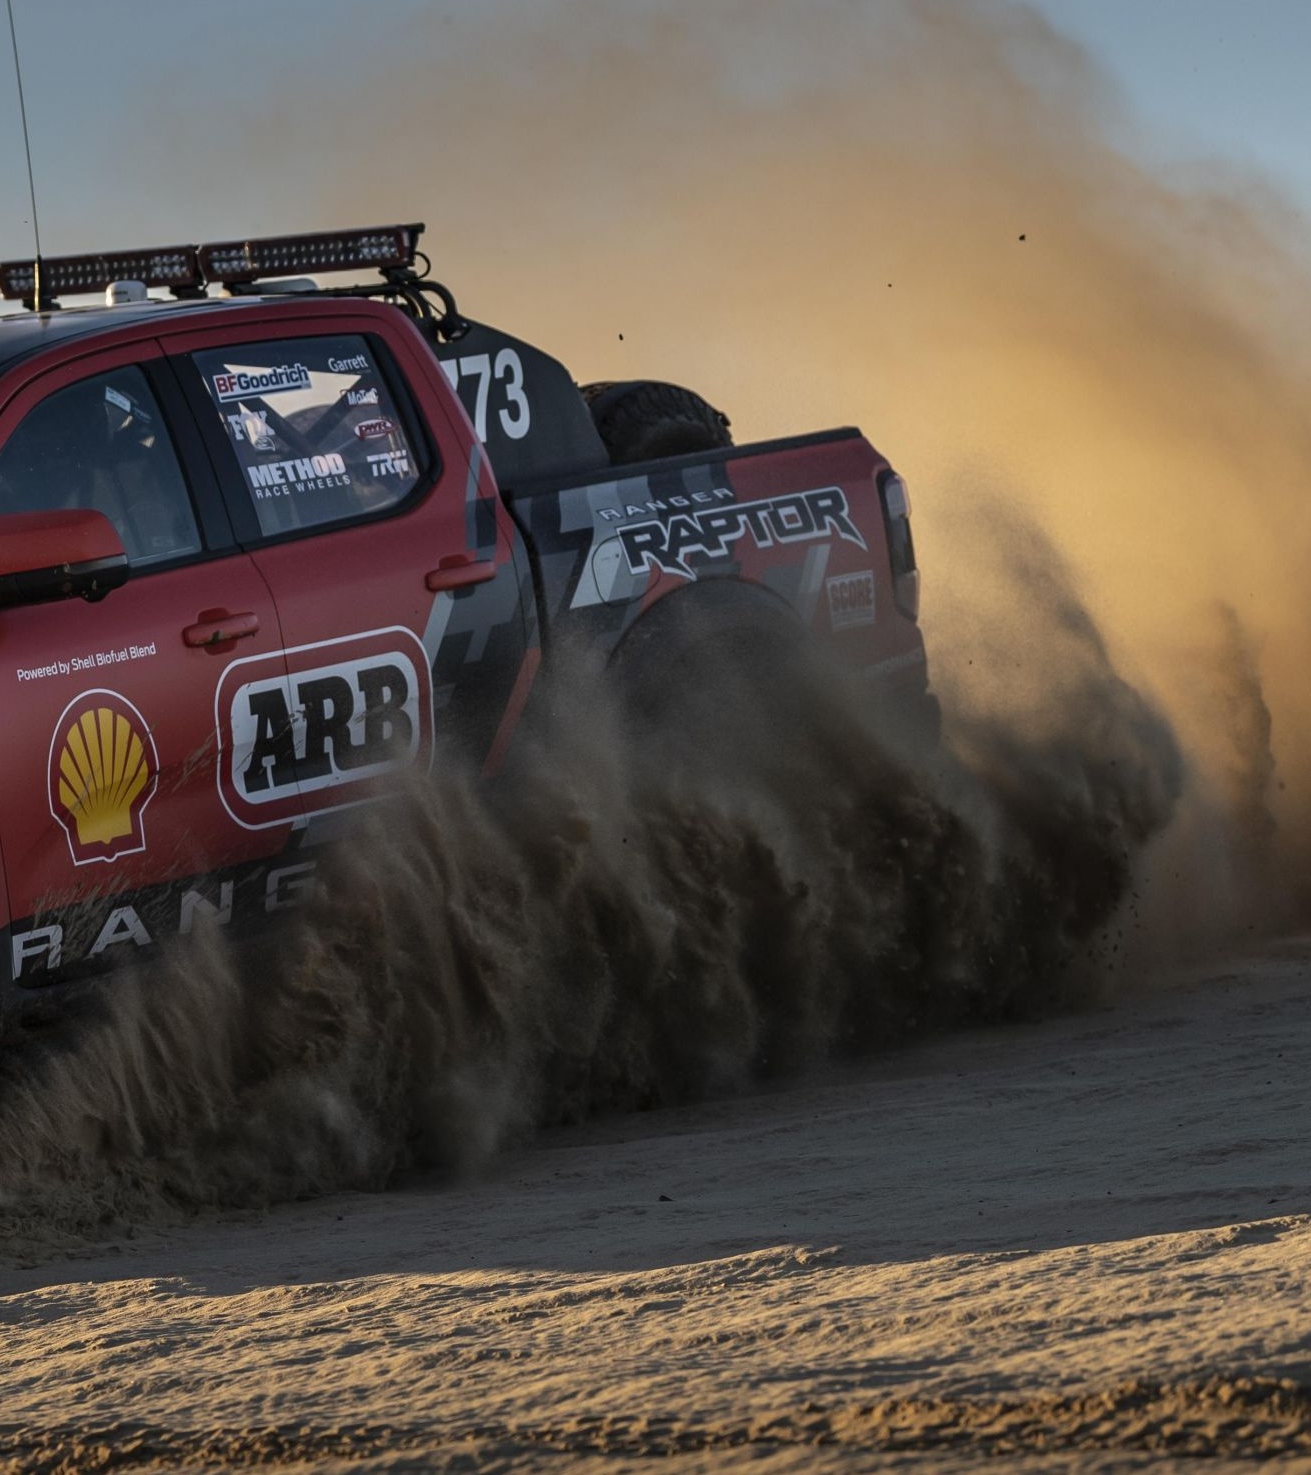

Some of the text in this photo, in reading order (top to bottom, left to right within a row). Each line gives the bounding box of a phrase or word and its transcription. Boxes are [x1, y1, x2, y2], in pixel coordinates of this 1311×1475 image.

[215, 364, 310, 394] BFGoodrich
[327, 354, 369, 373] Garrett
[247, 453, 347, 488] METHOD
[366, 450, 409, 477] TRW
[255, 474, 352, 500] RACE WHEELS
[598, 487, 735, 522] RANGER
[616, 486, 869, 582] RAPTOR
[16, 641, 157, 682] Powered by Shell Biofuel Blend
[243, 663, 414, 795] ARB
